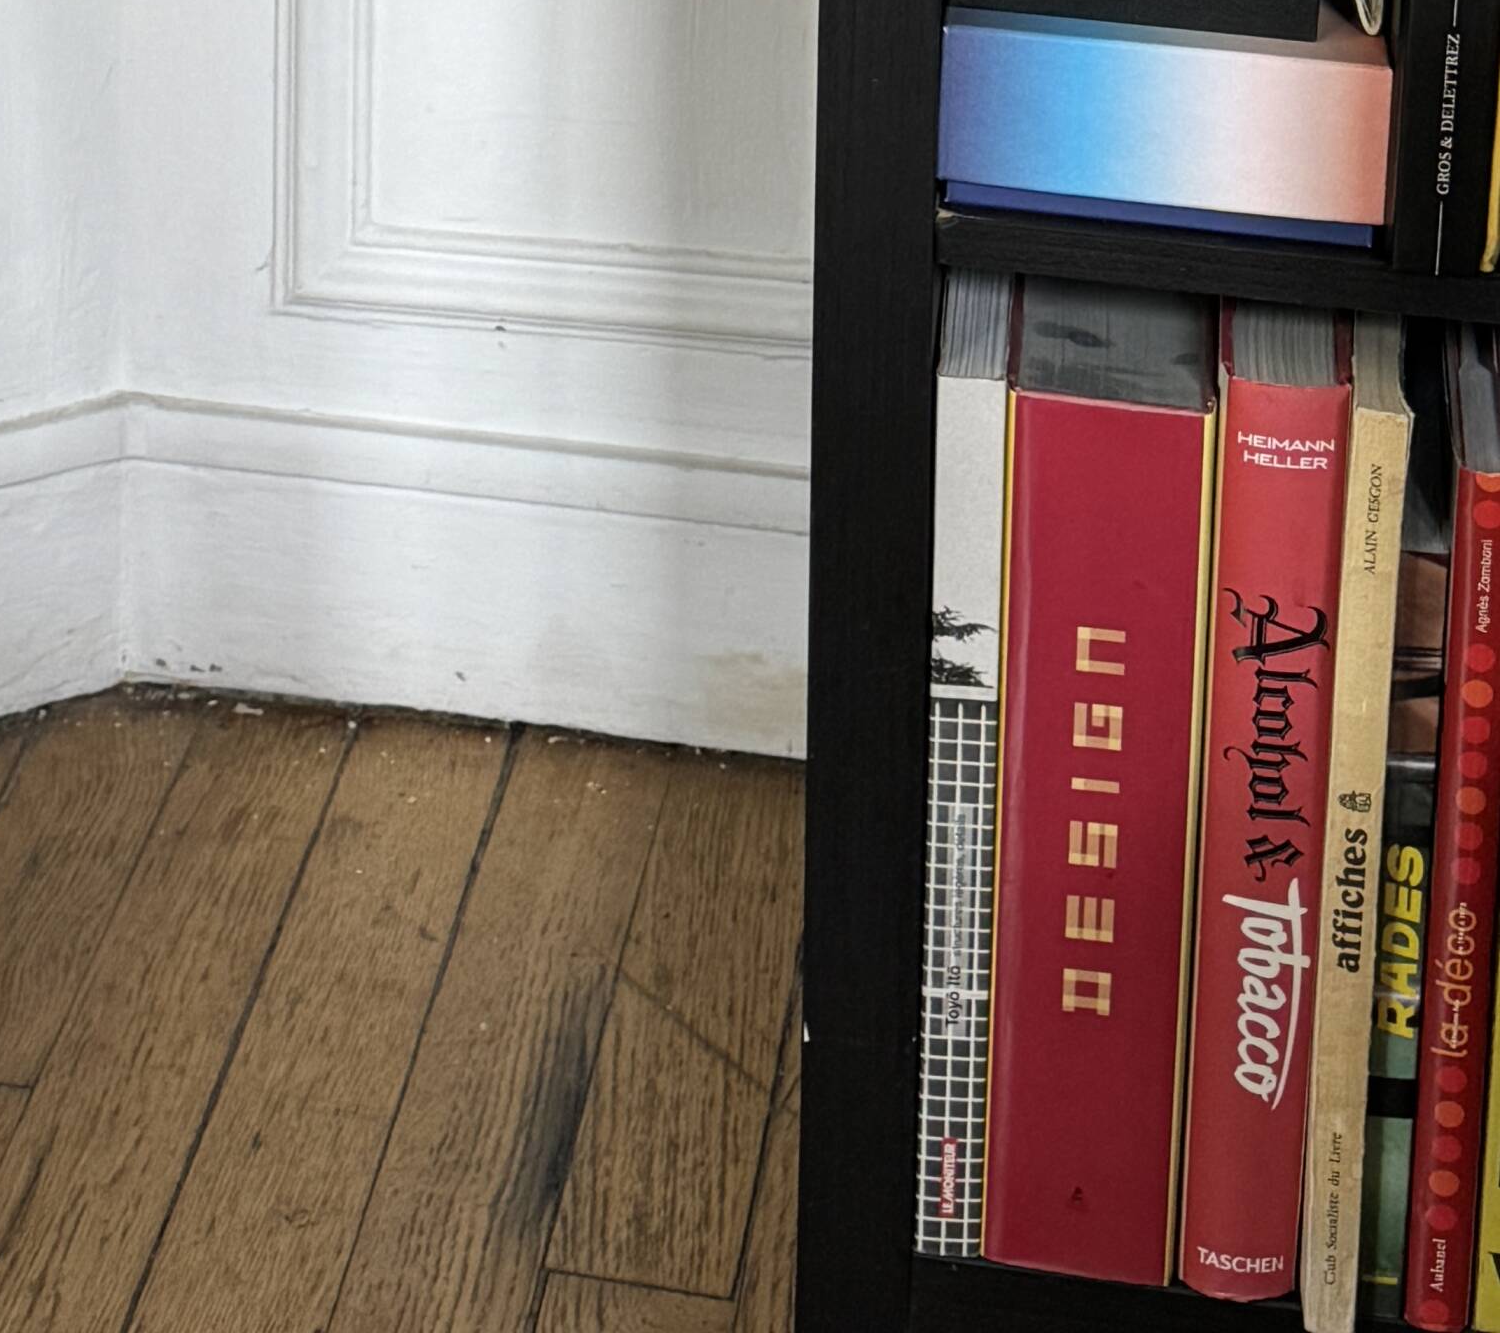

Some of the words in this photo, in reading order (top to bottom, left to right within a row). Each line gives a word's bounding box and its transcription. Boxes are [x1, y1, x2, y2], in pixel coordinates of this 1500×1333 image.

[1440, 32, 1461, 132] DELETTREZ
[1440, 136, 1452, 148] &
[1436, 151, 1452, 196] GROS
[1237, 431, 1335, 452] HEIMANN
[1243, 450, 1328, 470] HELLER
[1367, 464, 1384, 523] GESGON
[1363, 530, 1378, 575] ALAIN
[1477, 539, 1493, 593] Zamboni
[1475, 594, 1490, 634] Agnès
[1223, 587, 1331, 828] Alcohol
[1062, 626, 1127, 1016] DESIGN
[1242, 833, 1305, 883] &
[1332, 827, 1368, 973] affiches
[1377, 843, 1424, 1040] RADES
[1435, 907, 1478, 1007] déco
[1221, 877, 1311, 1112] Tobacco
[1430, 1022, 1469, 1058] la
[942, 1143, 957, 1202] MONITEUR
[1329, 1132, 1343, 1160] Livre
[1327, 1171, 1341, 1186] du
[1325, 1192, 1340, 1251] Socialiste
[1196, 1245, 1284, 1273] TASCHEN
[1429, 1238, 1447, 1292] Aubanel
